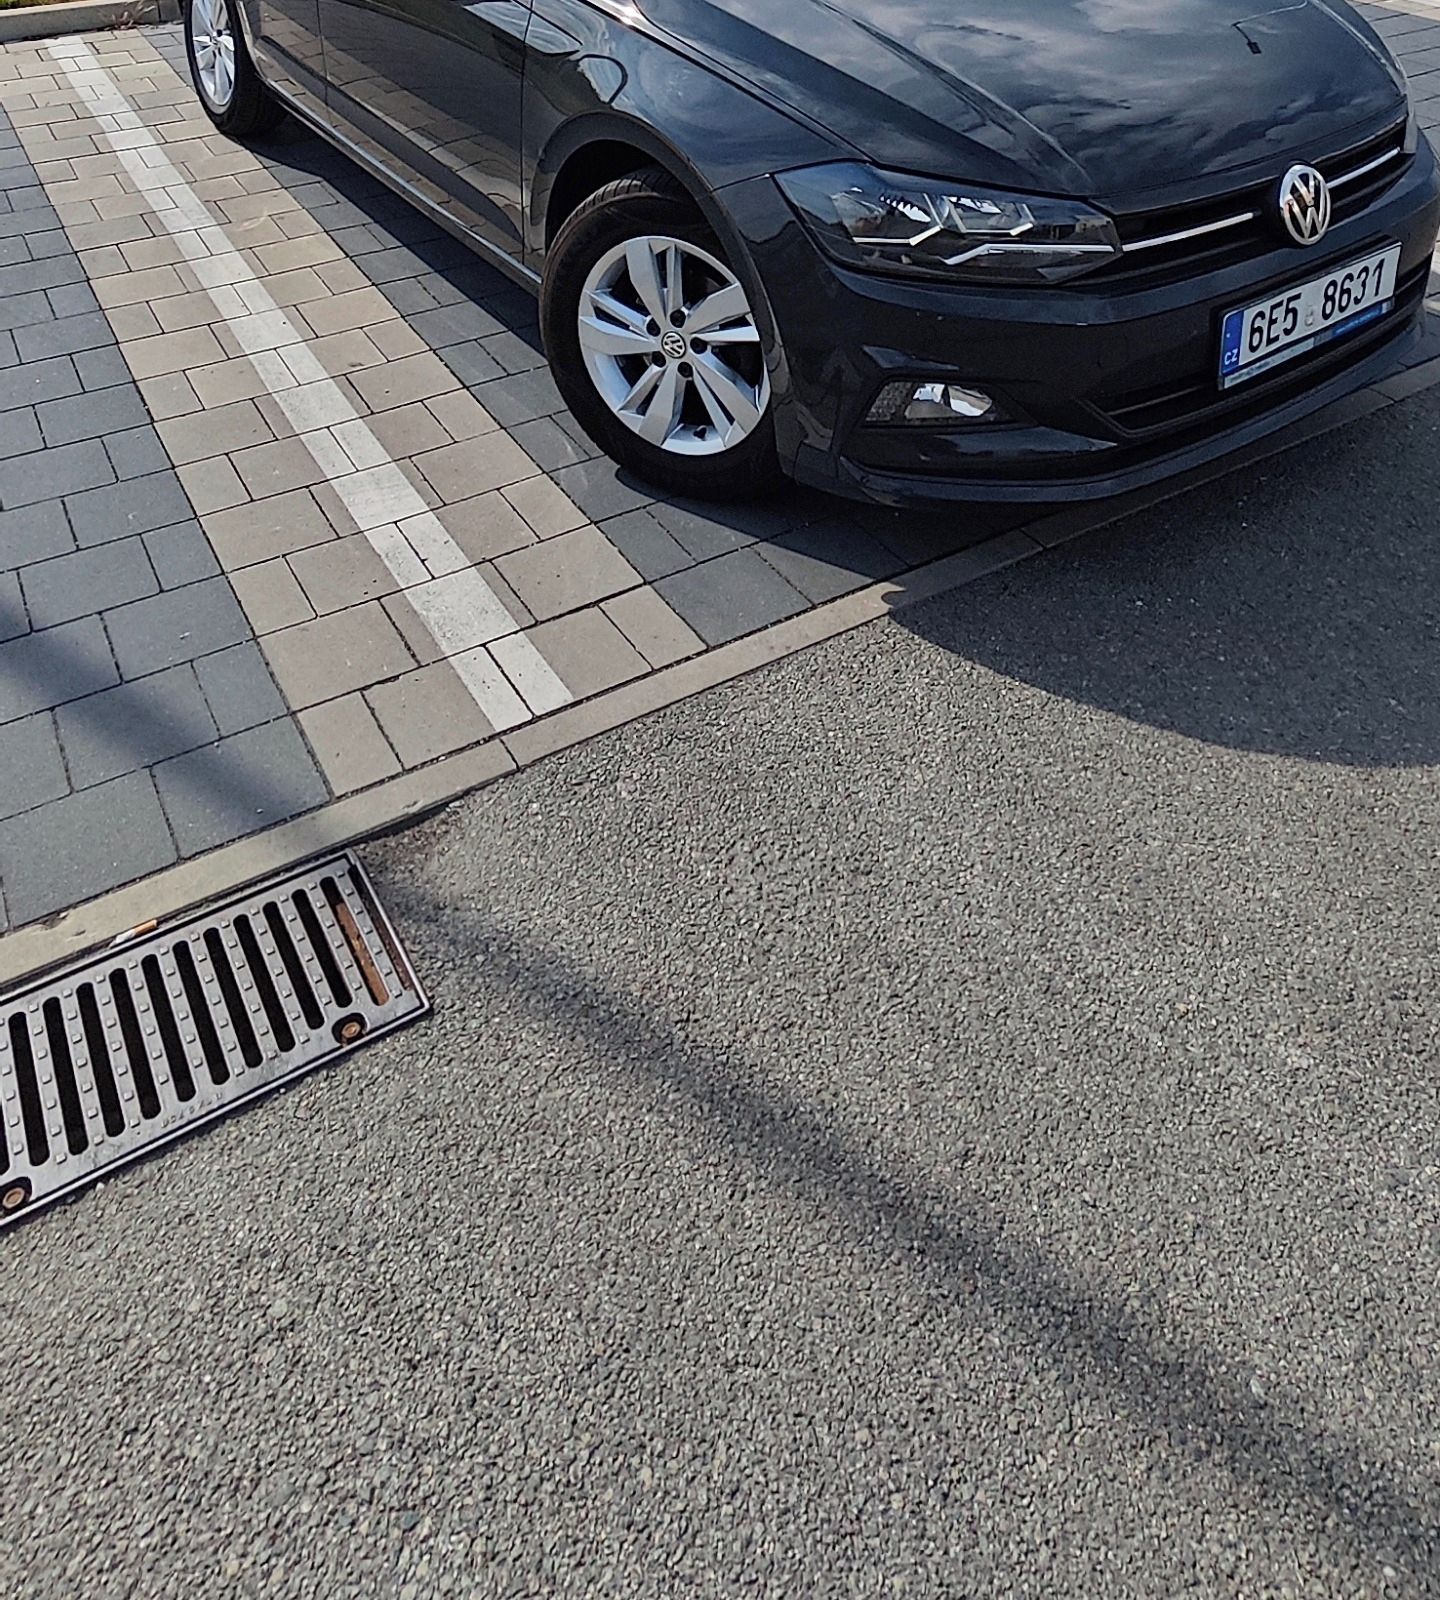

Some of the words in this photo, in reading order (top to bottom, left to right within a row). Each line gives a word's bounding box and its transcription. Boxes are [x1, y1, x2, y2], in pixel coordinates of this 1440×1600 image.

[1281, 167, 1329, 243] VW
[1248, 293, 1302, 353] 6E5
[1321, 258, 1386, 321] 8631
[1223, 347, 1239, 366] CZ
